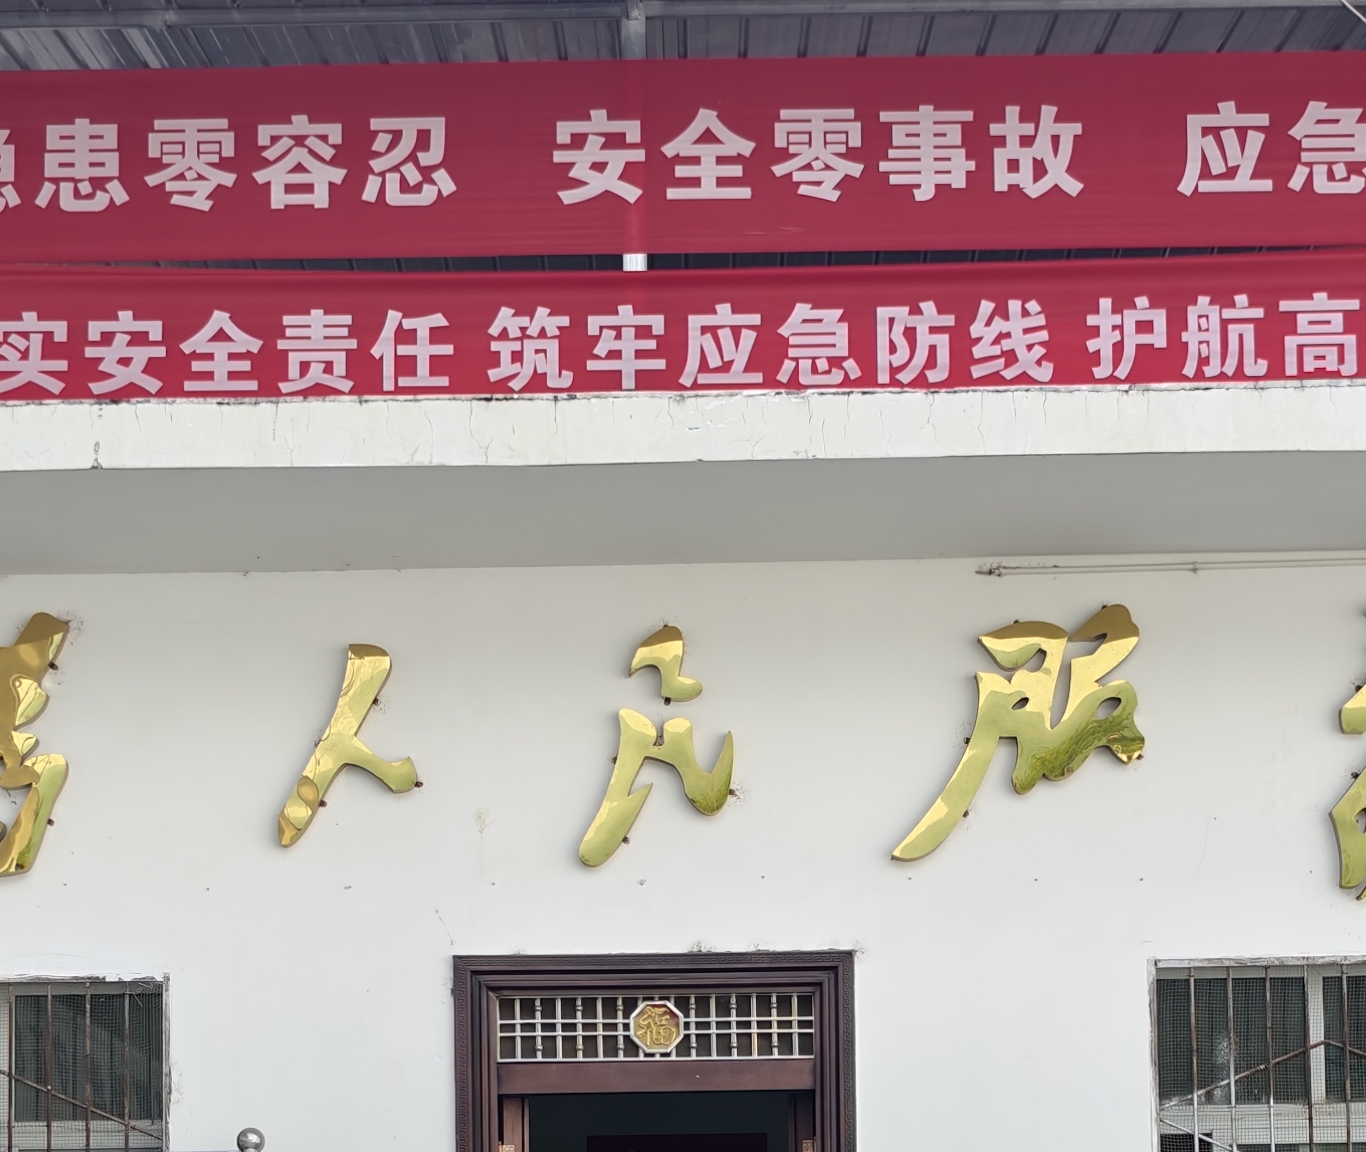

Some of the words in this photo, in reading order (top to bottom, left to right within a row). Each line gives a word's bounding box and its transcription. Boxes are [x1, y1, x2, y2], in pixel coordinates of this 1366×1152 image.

[552, 104, 1085, 204] 安全零事故
[487, 299, 1053, 393] 筑牢应急防线
